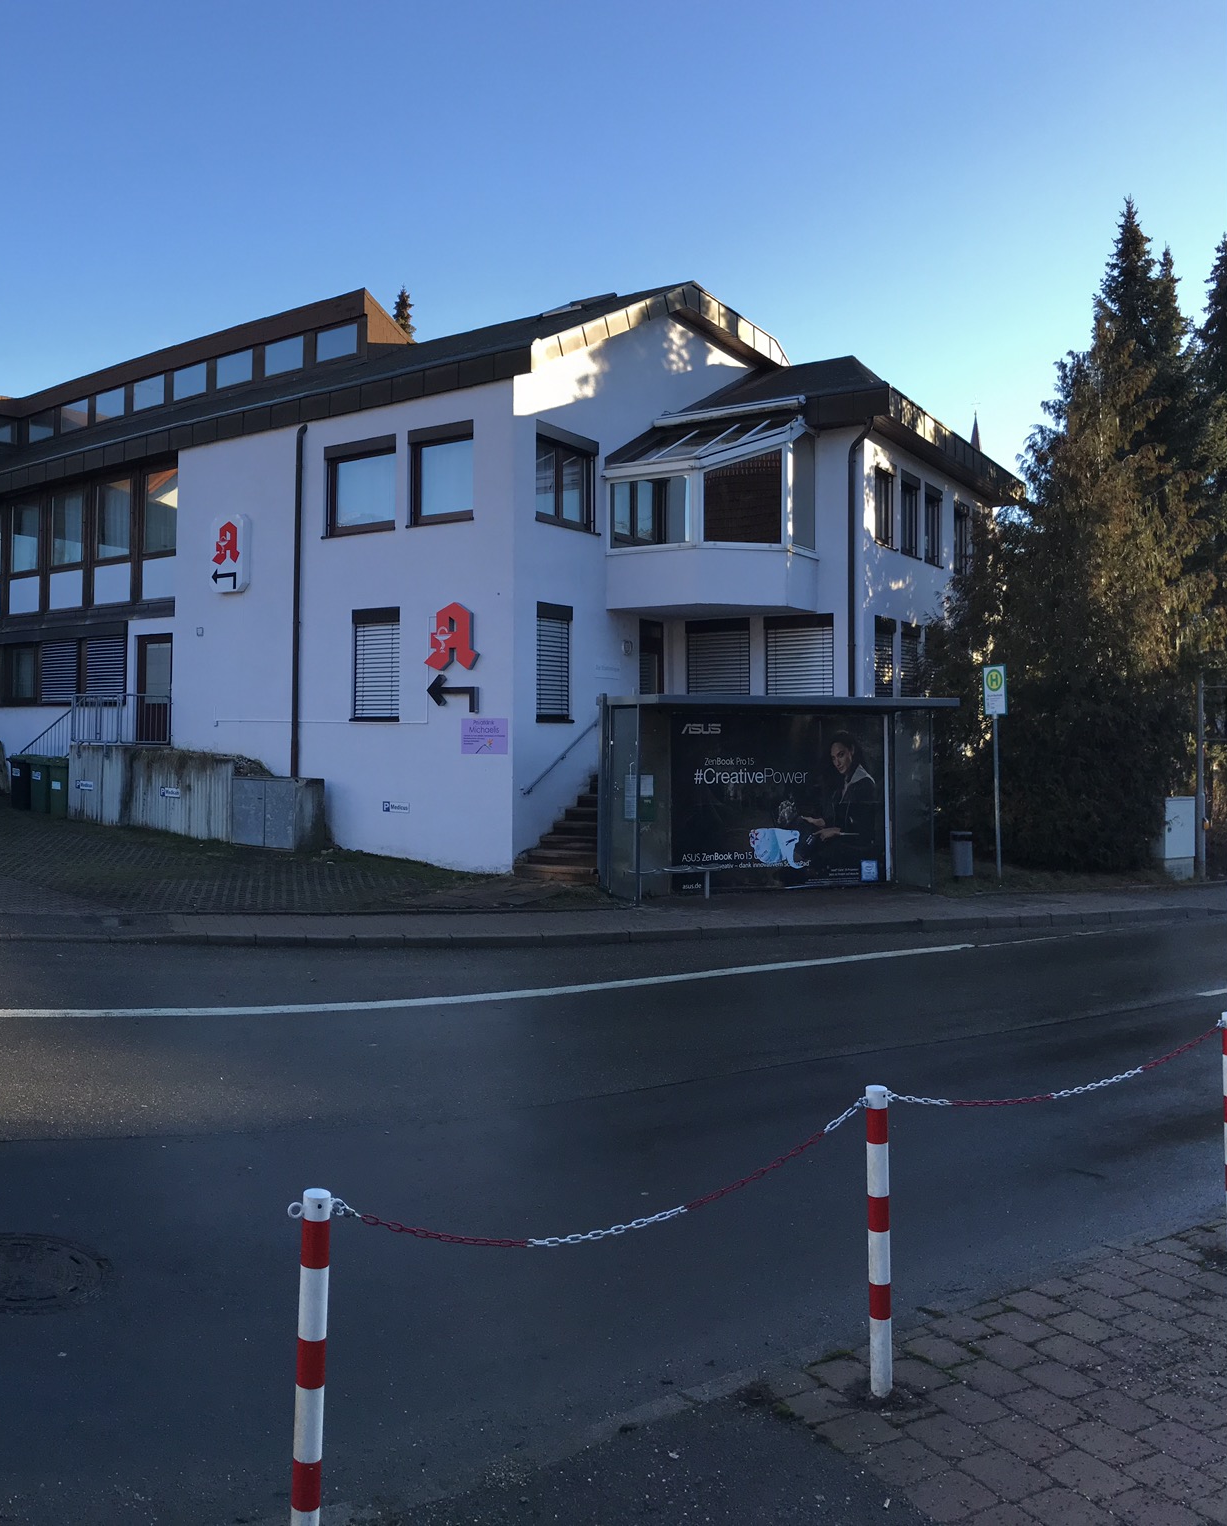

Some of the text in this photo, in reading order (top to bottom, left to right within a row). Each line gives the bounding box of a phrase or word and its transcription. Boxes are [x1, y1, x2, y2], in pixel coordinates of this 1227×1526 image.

[681, 723, 722, 734] ASUS
[704, 757, 735, 766] ZenBook
[694, 768, 809, 784] #CreativePower
[682, 853, 701, 862] ASUS
[702, 852, 733, 861] ZenBook
